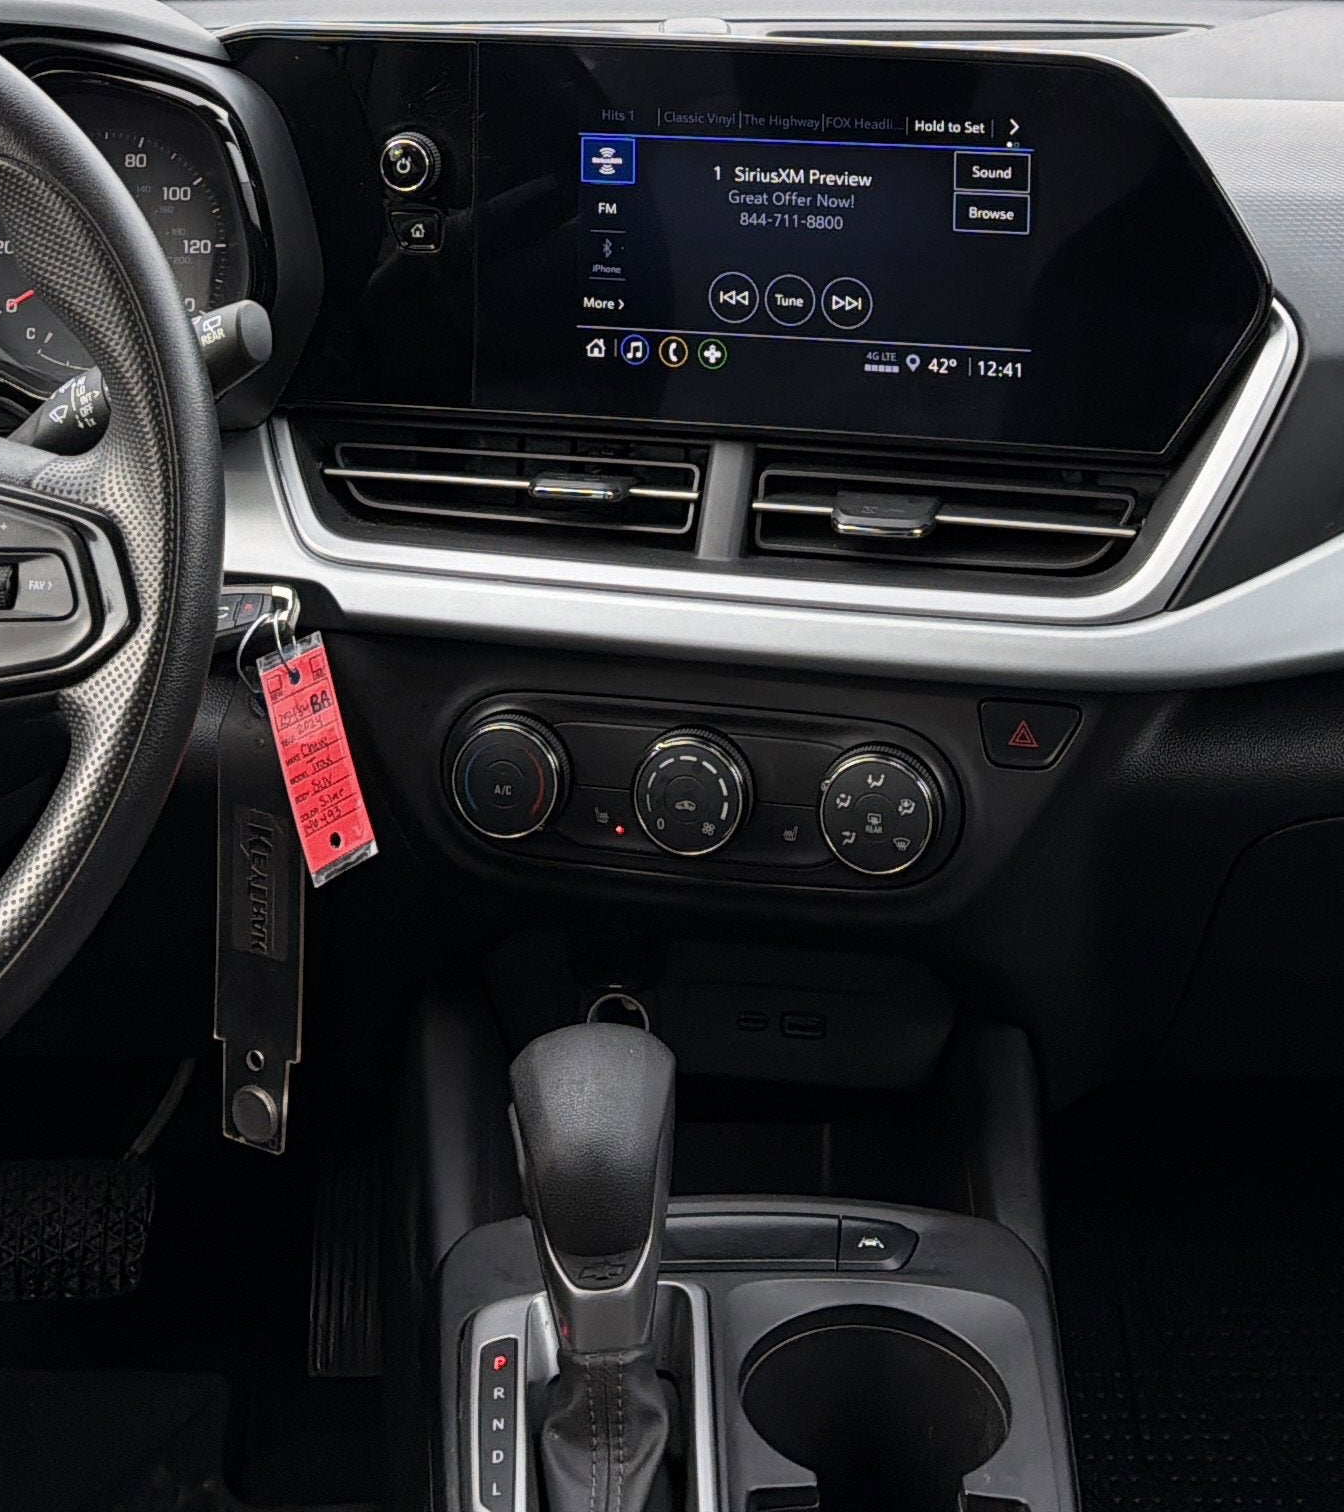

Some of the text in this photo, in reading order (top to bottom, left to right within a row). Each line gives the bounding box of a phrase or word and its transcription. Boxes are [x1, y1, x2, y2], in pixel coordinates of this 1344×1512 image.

[602, 109, 626, 121] Hits
[663, 111, 736, 128] Classic Vinyl
[743, 114, 820, 131] The Highway
[826, 117, 852, 129] FOX
[914, 119, 985, 135] Hold to Set
[124, 154, 147, 168] 80
[713, 166, 872, 187] 1 SiriusXM Preview
[972, 166, 1012, 180] Sound
[162, 187, 191, 201] 100
[728, 190, 855, 209] Great Offer Now!
[597, 202, 617, 215] FM
[968, 206, 1014, 221] Browse
[739, 212, 844, 230] 844-711-8800
[182, 240, 211, 254] 120
[592, 264, 621, 275] iPhone
[583, 297, 615, 310] More
[774, 294, 804, 308] Tune
[26, 328, 36, 340] C
[200, 328, 226, 346] REAR
[866, 351, 897, 362] 4G LTE
[977, 360, 1023, 378] 12:41
[80, 391, 93, 406] INT
[79, 402, 95, 418] OFF
[28, 580, 48, 590] FAV
[309, 689, 331, 714] BA
[297, 714, 324, 735] 2024
[311, 773, 333, 793] SUV
[494, 783, 512, 796] A/C
[865, 824, 883, 835] REAR
[493, 1355, 507, 1370] P
[493, 1386, 505, 1399] R
[493, 1418, 505, 1430] N
[492, 1450, 504, 1463] D
[492, 1482, 501, 1496] L
